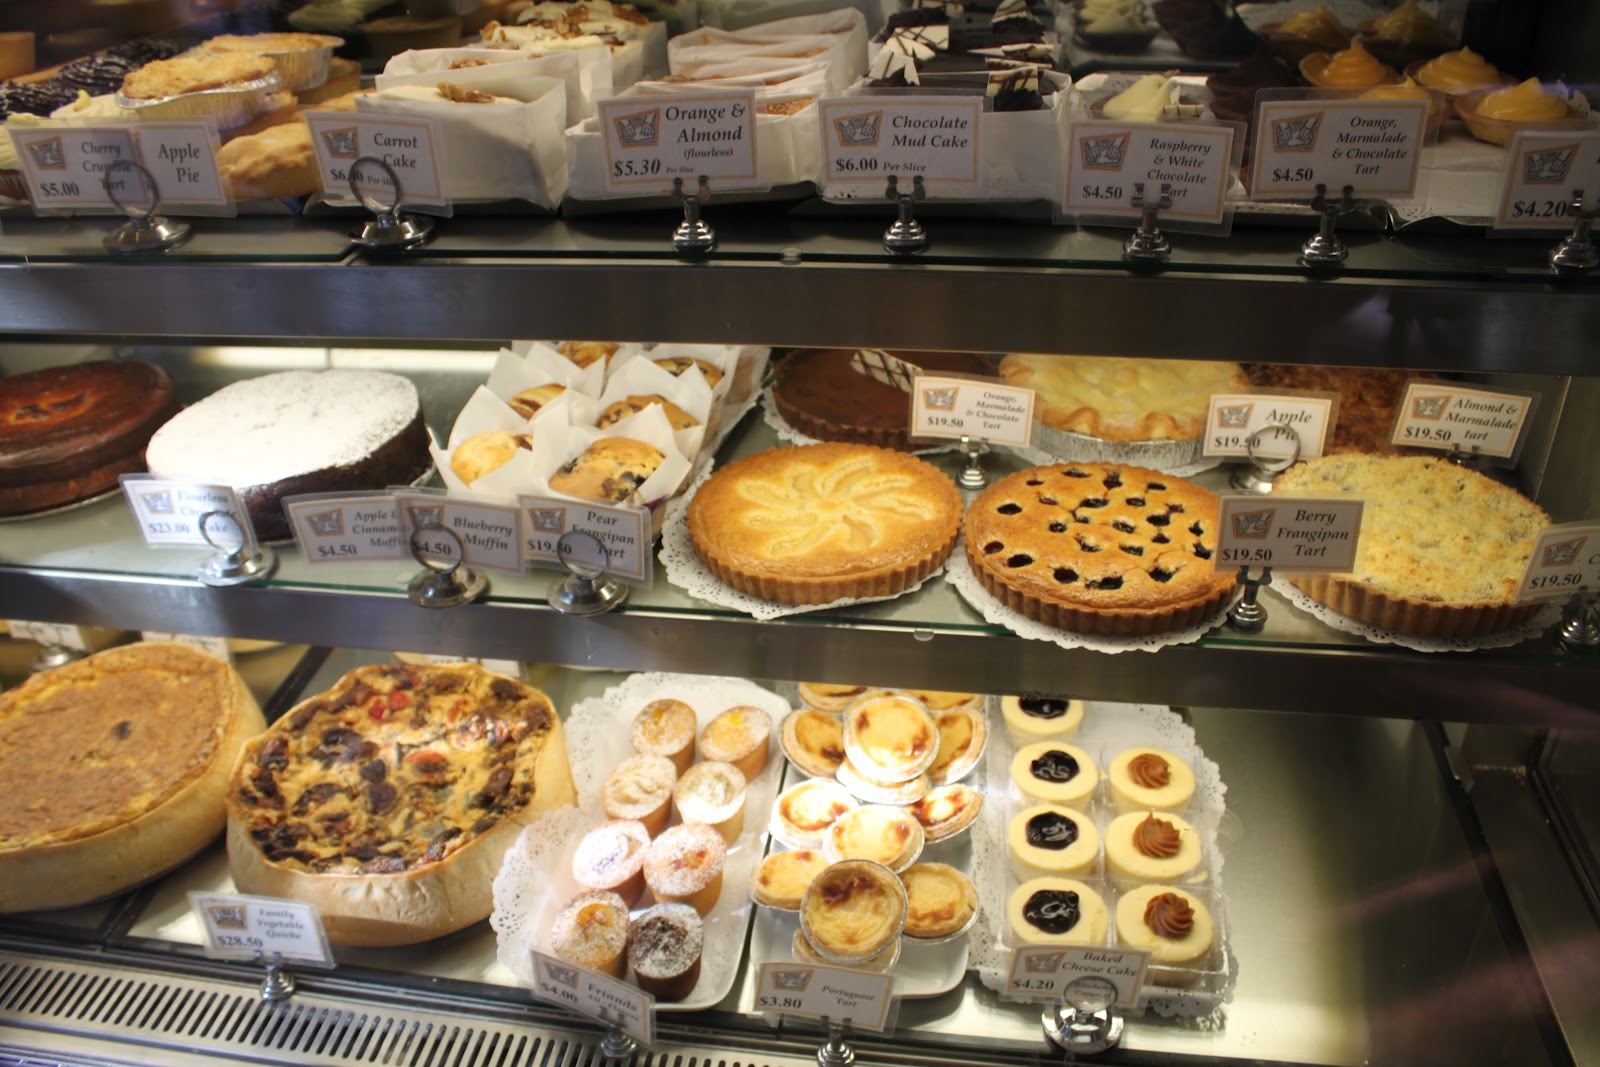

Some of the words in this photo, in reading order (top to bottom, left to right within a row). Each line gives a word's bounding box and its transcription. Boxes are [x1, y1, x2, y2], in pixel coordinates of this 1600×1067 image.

[665, 106, 726, 124] Orange
[731, 103, 746, 118] &
[892, 115, 968, 129] Chocolate
[1350, 116, 1397, 130] Orange,
[374, 132, 418, 148] Carrot
[676, 125, 743, 143] Almond
[892, 134, 926, 147] Mud
[931, 135, 968, 148] Cake
[1336, 132, 1407, 144] Marmalade
[81, 142, 121, 157] Cherry
[158, 143, 200, 163] Apple
[684, 147, 734, 161] (flourless)
[1150, 138, 1211, 156] Raspberry
[1332, 149, 1344, 159] &
[1346, 147, 1408, 160] Chocolate
[382, 153, 417, 168] Cake
[614, 158, 661, 177] $5.30
[666, 166, 678, 174] Per
[679, 166, 695, 174] Slice
[836, 157, 878, 172] $6.00
[883, 162, 900, 171] Per
[902, 162, 927, 172] Slice
[1154, 154, 1164, 165] &
[1168, 156, 1204, 168] White
[176, 167, 200, 182] Pie
[330, 168, 364, 182] $6.0
[1272, 167, 1314, 183] $4.50
[1354, 163, 1381, 175] Tart
[367, 175, 382, 184] Per
[382, 176, 400, 187] Sli
[1147, 169, 1207, 184] Chocolate
[40, 183, 80, 197] $5.00
[99, 178, 125, 190] Tart
[1082, 185, 1123, 200] $4.50
[1167, 187, 1188, 197] art
[1512, 200, 1568, 218] $4.20
[976, 401, 1026, 414] Marmalade
[1454, 398, 1504, 413] Almond
[1506, 404, 1519, 414] &
[927, 416, 964, 428] $19.50
[966, 409, 974, 417] &
[976, 410, 1020, 423] Chocolate
[1266, 409, 1313, 426] Apple
[1445, 412, 1517, 430] Marmalade
[982, 421, 1002, 430] Tart
[1404, 426, 1452, 441] $19.50
[1464, 429, 1489, 441] tart
[177, 490, 229, 504] Flourless
[354, 510, 388, 522] Apple
[587, 511, 619, 526] Pear
[1295, 509, 1337, 526] Berry
[148, 522, 191, 535] $23.00
[352, 524, 400, 535] Cinnam
[453, 517, 513, 537] Blueberry
[1277, 527, 1350, 542] Frangipan
[412, 541, 452, 556] $4.50
[463, 533, 509, 551] Muffin
[317, 543, 357, 557] $4.50
[1222, 549, 1273, 562] $19.50
[1294, 544, 1328, 557] Tart
[1529, 573, 1582, 590] $19.50
[259, 908, 295, 919] Family
[256, 919, 304, 930] Vegetable
[217, 935, 263, 948] $28.50
[266, 930, 302, 940] Quiche
[1083, 951, 1124, 963] Baked
[1062, 961, 1104, 973] Cheese
[1107, 966, 1139, 977] Cake
[1012, 979, 1055, 990] $4.20
[541, 982, 578, 1003] $4.00
[587, 983, 638, 1012] Friands
[821, 984, 876, 1001] Portuguese
[759, 996, 802, 1009] $3.80
[837, 997, 858, 1008] Tart
